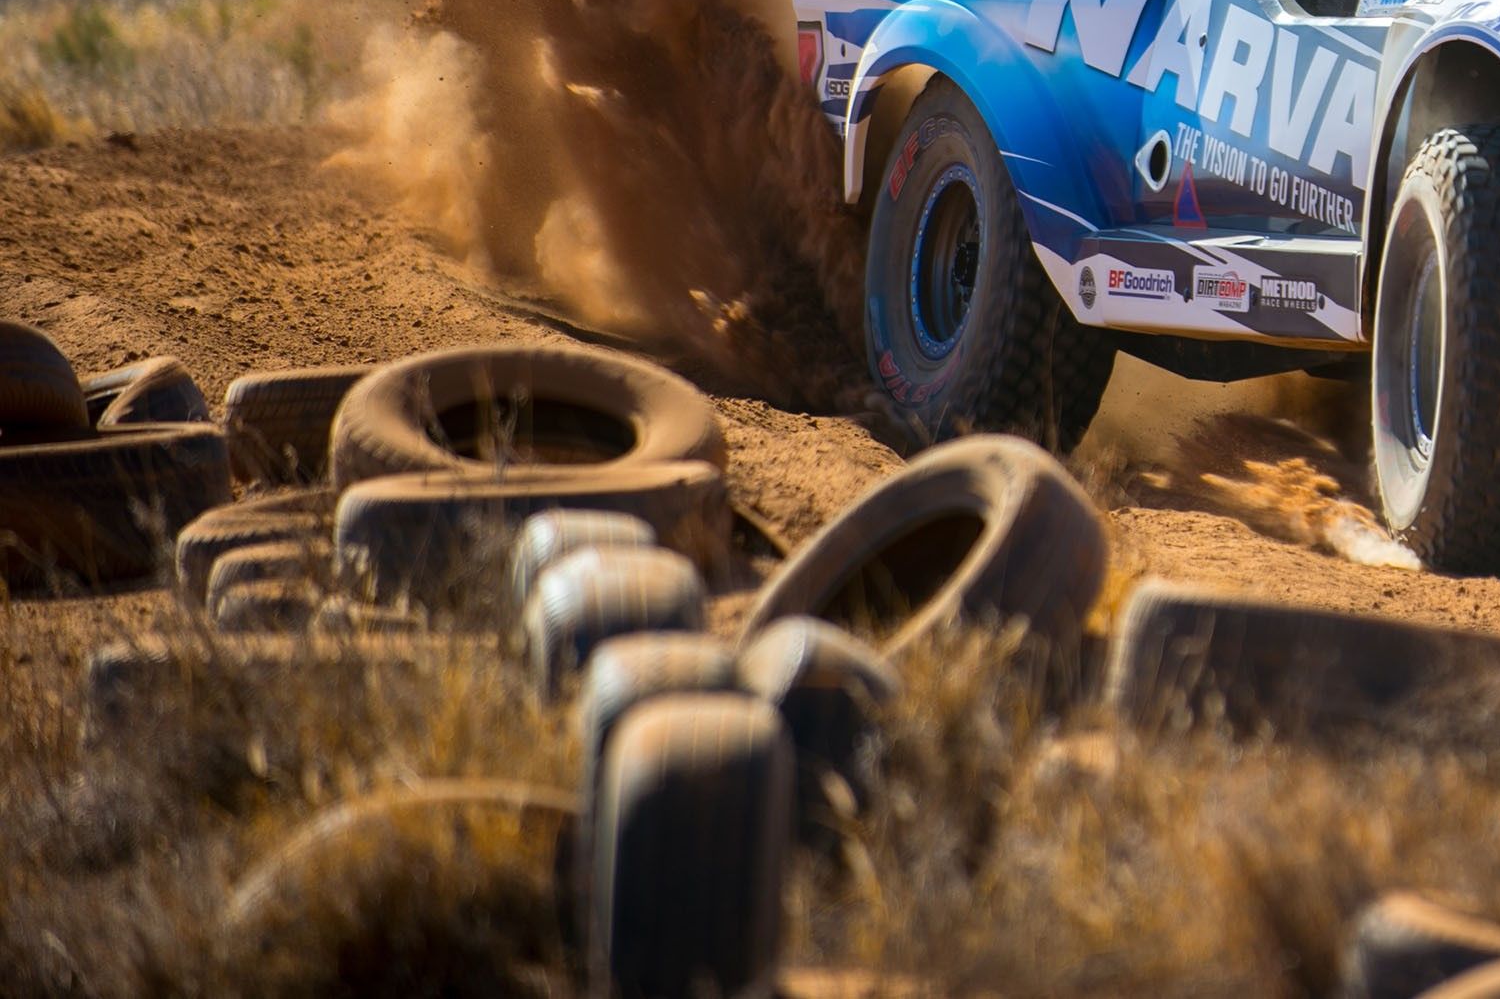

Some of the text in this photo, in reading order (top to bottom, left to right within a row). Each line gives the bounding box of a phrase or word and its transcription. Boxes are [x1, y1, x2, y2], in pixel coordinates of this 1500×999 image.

[1174, 122, 1357, 234] THE VISION TO GO FURTHER
[1108, 269, 1172, 293] BFGoodrich
[1261, 278, 1317, 300] METHOD
[1261, 298, 1317, 310] RACE WHEELS
